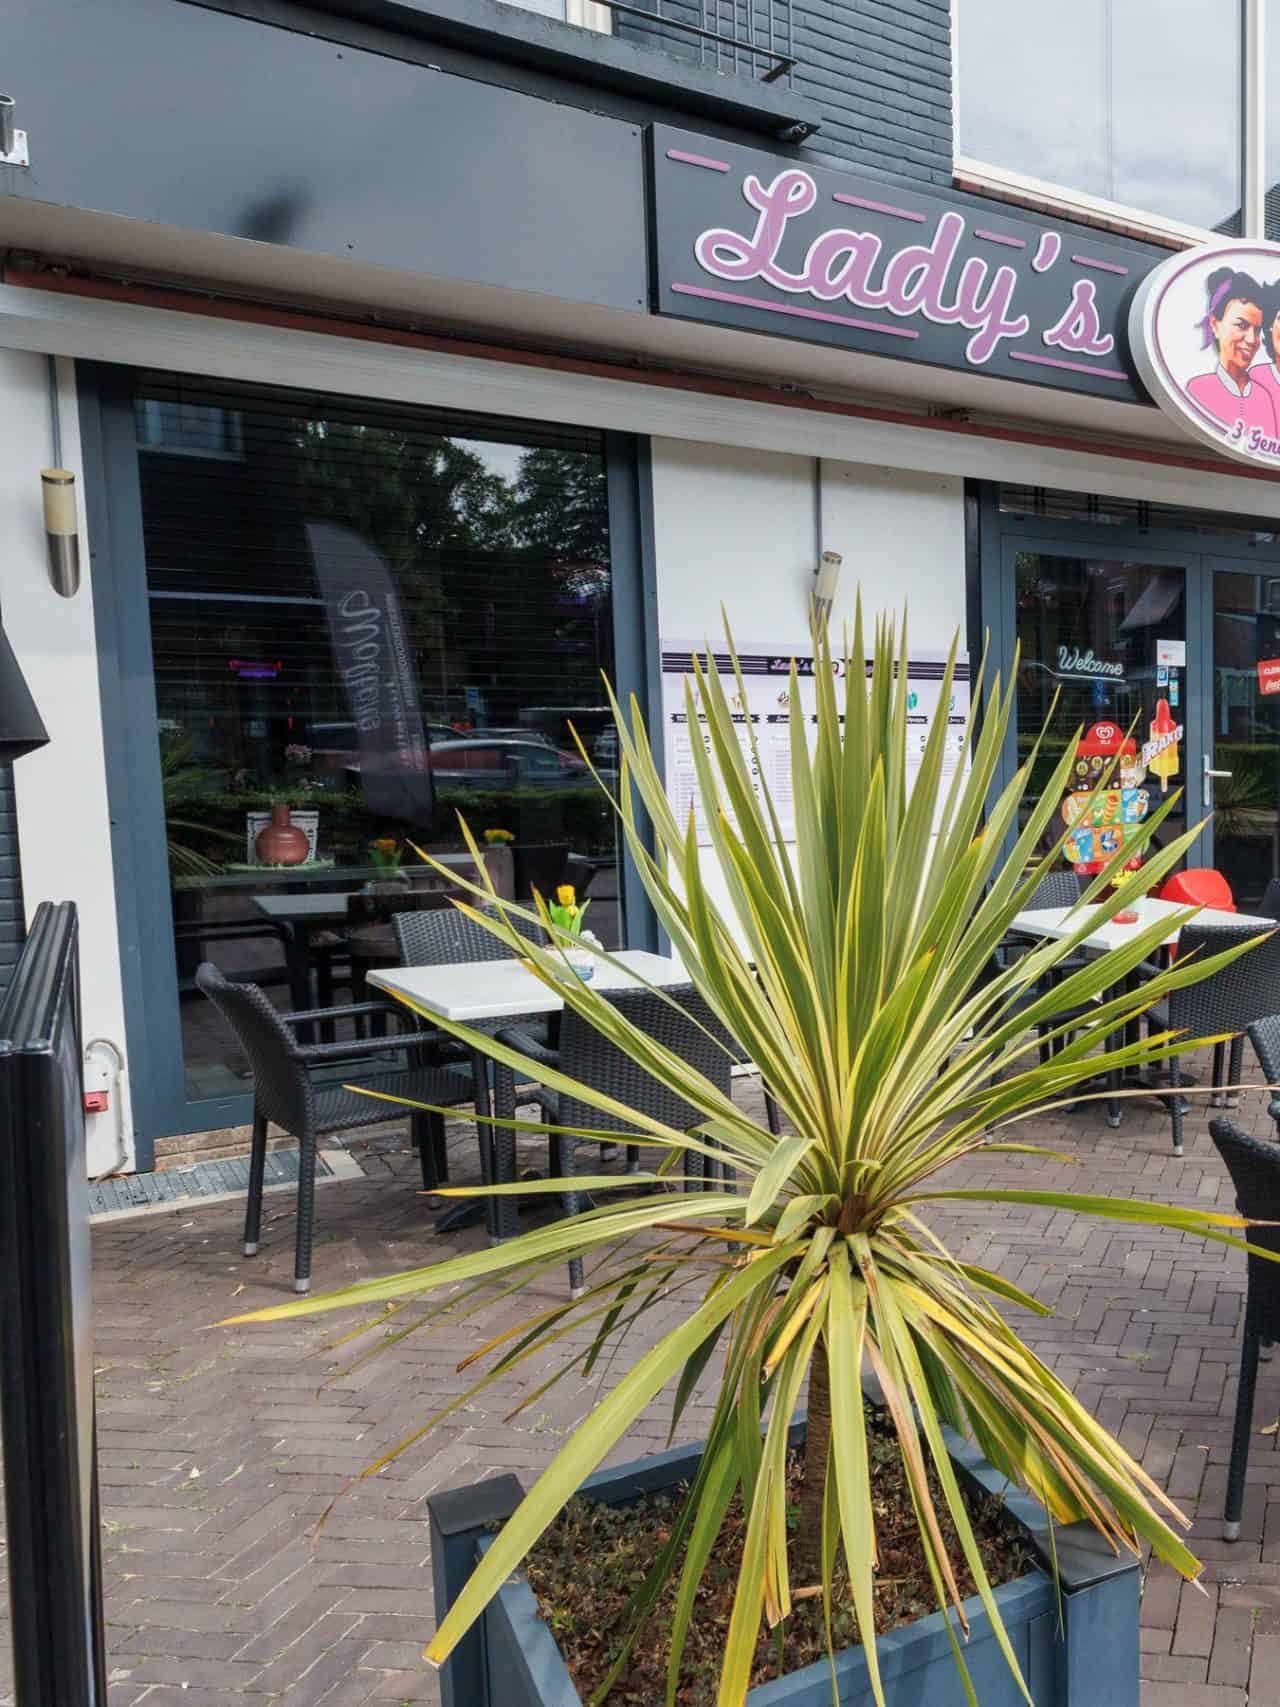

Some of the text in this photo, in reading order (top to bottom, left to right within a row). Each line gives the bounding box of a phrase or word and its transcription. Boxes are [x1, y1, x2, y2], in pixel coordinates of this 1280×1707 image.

[695, 169, 1115, 364] Lady's
[1231, 421, 1244, 440] 3
[1059, 646, 1124, 676] Welcome
